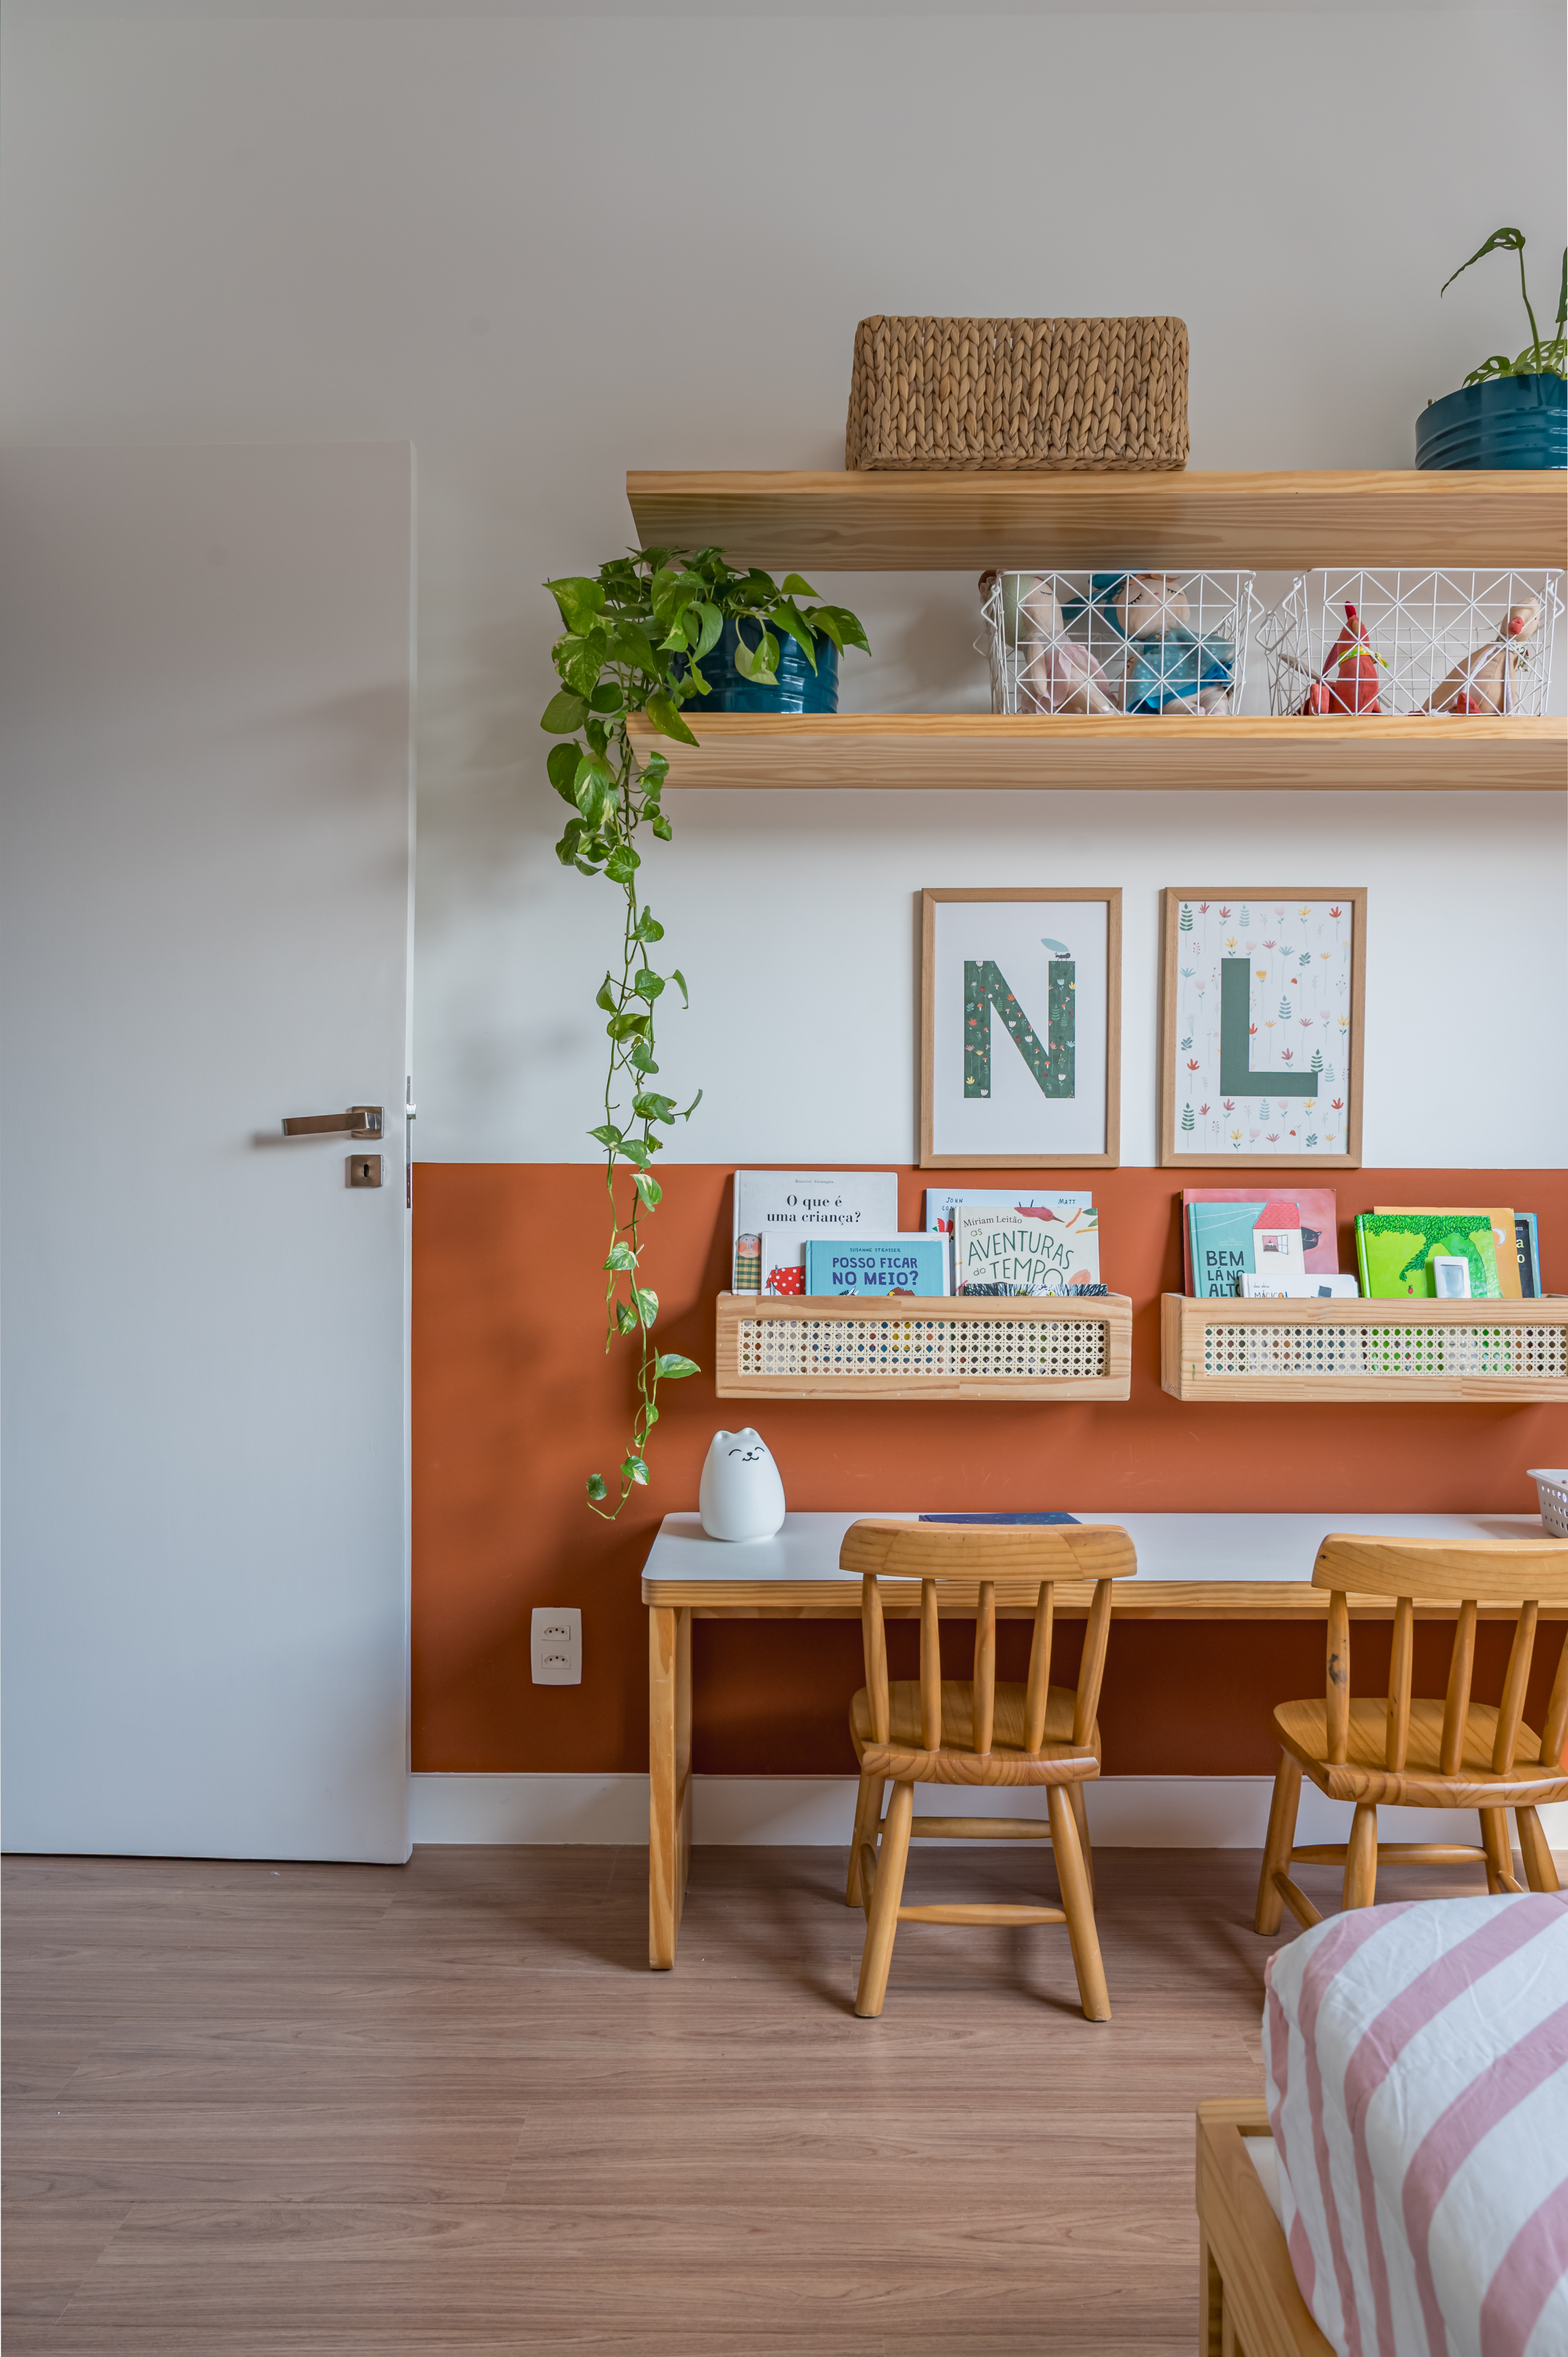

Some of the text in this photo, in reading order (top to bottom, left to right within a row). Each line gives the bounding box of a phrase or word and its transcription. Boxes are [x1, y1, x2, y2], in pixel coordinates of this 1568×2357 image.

[964, 961, 1075, 1098] N
[1220, 958, 1318, 1097] L
[787, 1195, 842, 1210] O que é
[767, 1211, 861, 1225] uma criança?
[963, 1216, 1022, 1227] Míriam Leitão
[971, 1228, 983, 1237] as
[968, 1230, 1074, 1270] AVENTURAS
[833, 1257, 918, 1269] POSSO FICAR
[1206, 1251, 1244, 1266] BEM
[832, 1270, 919, 1286] NO MEIO?
[973, 1257, 1063, 1284] do TEMPO
[1208, 1267, 1224, 1281] LÁ
